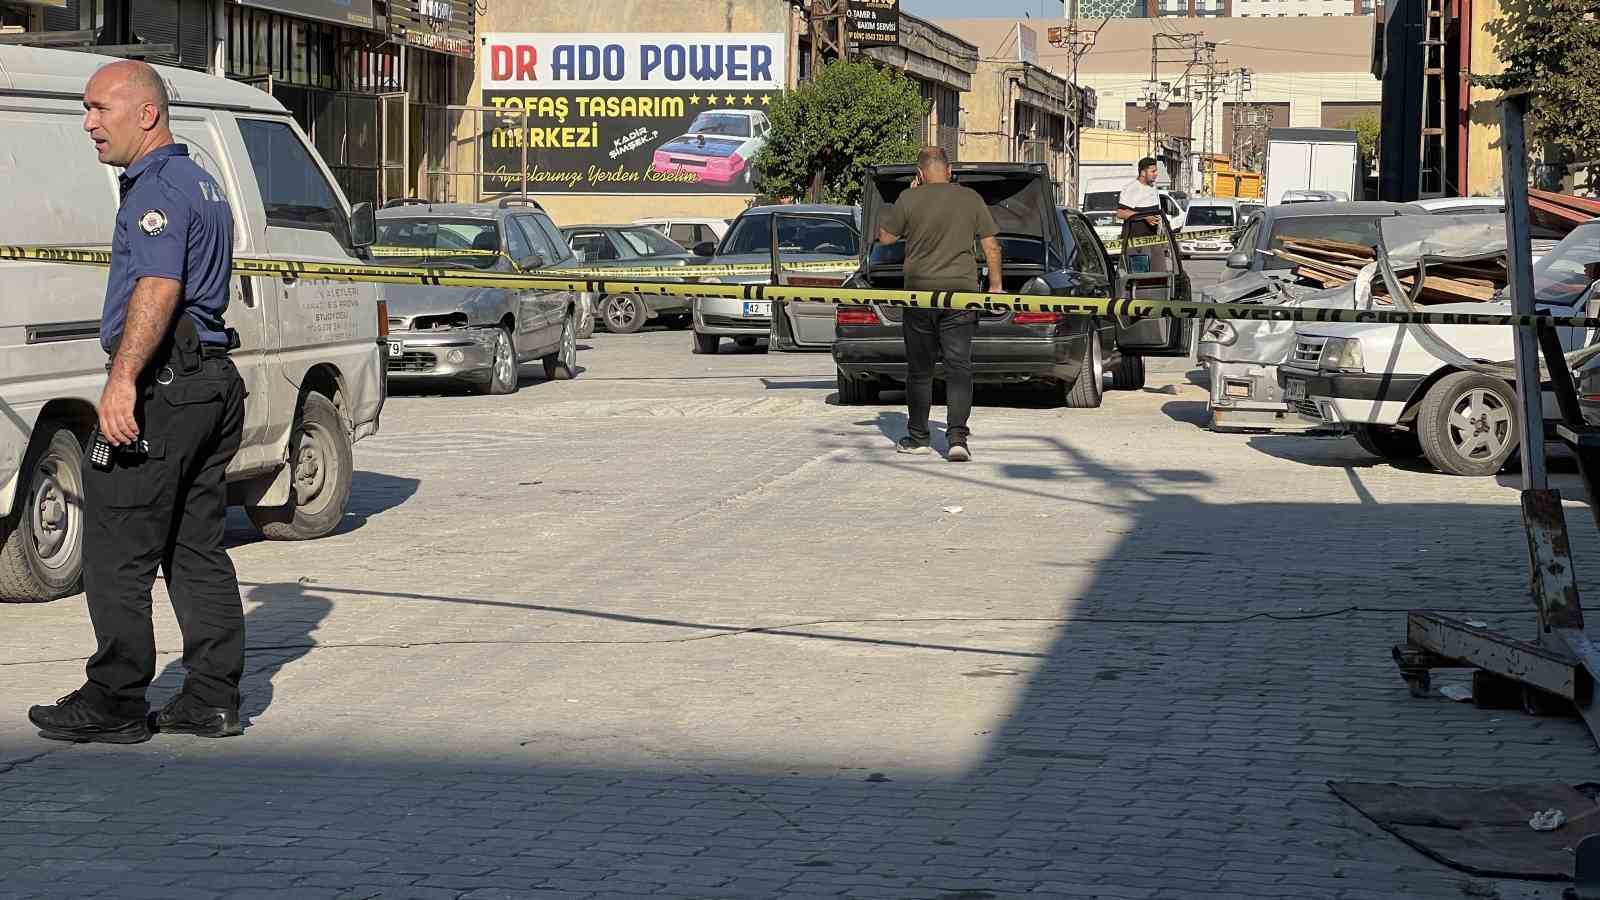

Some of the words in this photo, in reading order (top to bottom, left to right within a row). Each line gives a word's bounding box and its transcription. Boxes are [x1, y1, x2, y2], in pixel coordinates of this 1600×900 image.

[490, 44, 537, 81] DR
[550, 44, 625, 81] ADO
[640, 44, 772, 81] POWER
[491, 96, 569, 123] TOFAŞ
[575, 96, 684, 118] TASARIM
[491, 121, 599, 148] MERKEZİ
[588, 164, 640, 187] Yerden
[643, 161, 697, 184] Keselim
[749, 303, 759, 313] 42
